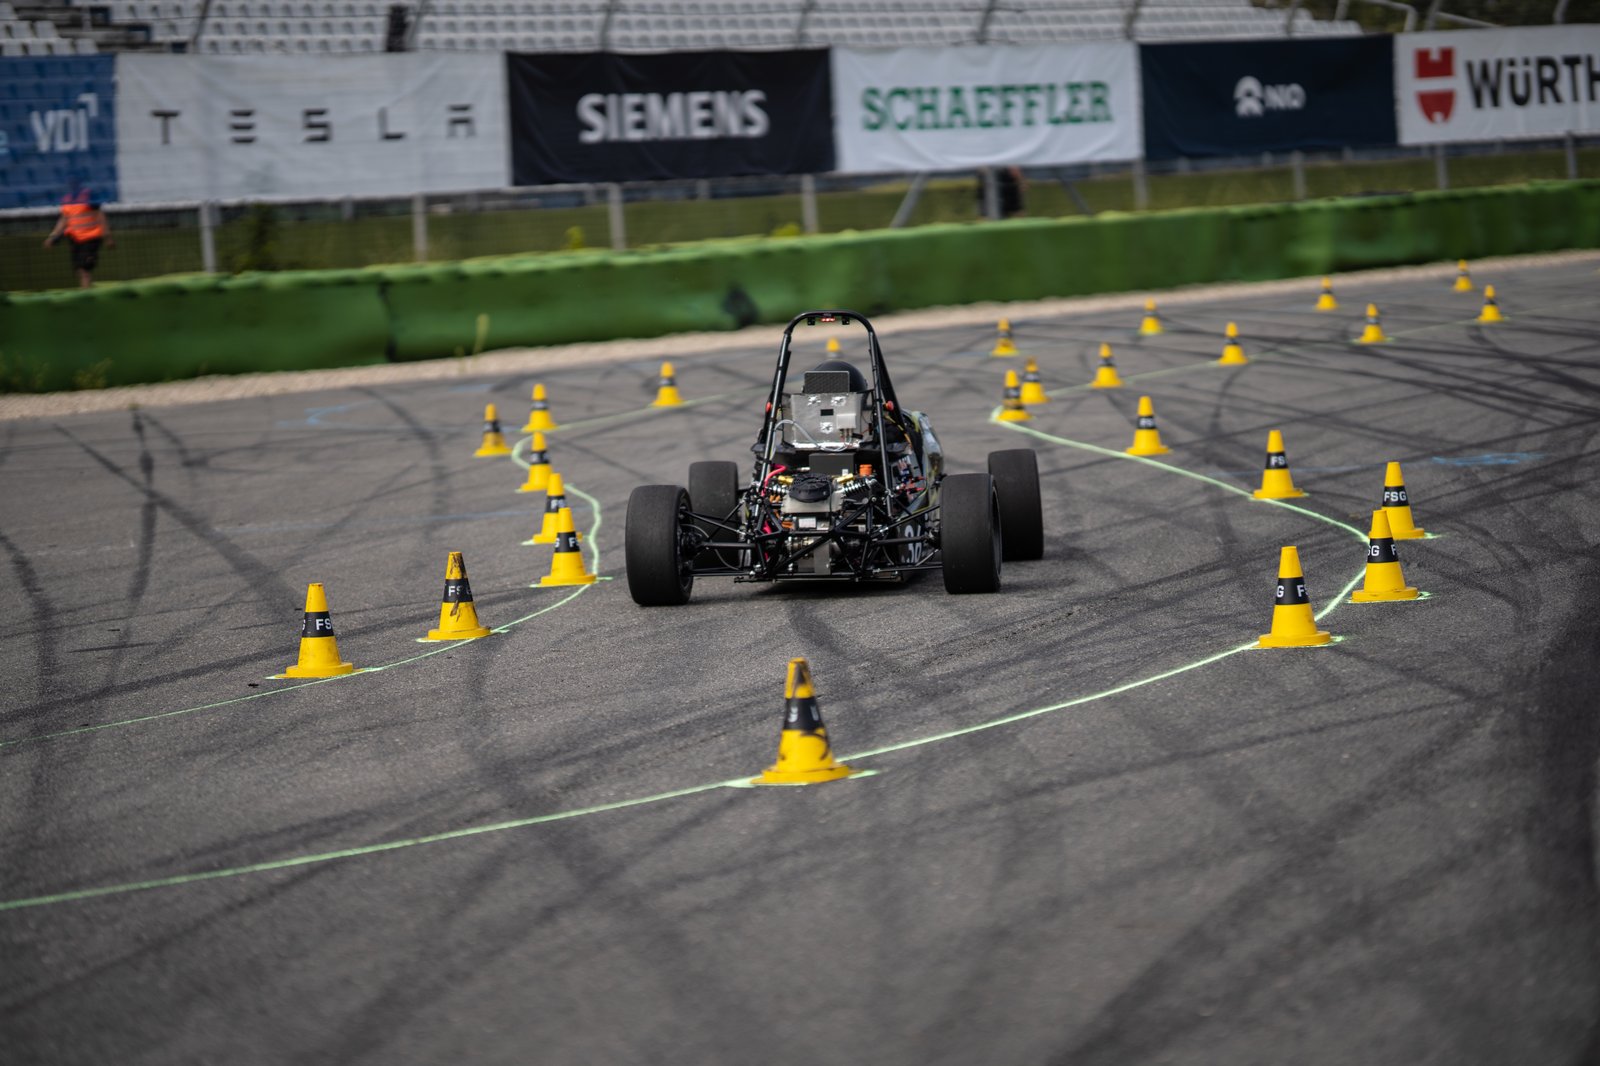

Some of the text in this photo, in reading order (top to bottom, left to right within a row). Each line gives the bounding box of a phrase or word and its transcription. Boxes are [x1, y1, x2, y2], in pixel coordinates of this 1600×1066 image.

[151, 104, 476, 145] TESLA
[577, 90, 769, 144] SIEMENS
[861, 81, 1113, 132] SCHAEFFLER
[31, 109, 88, 152] VDI
[1384, 491, 1407, 502] FSG
